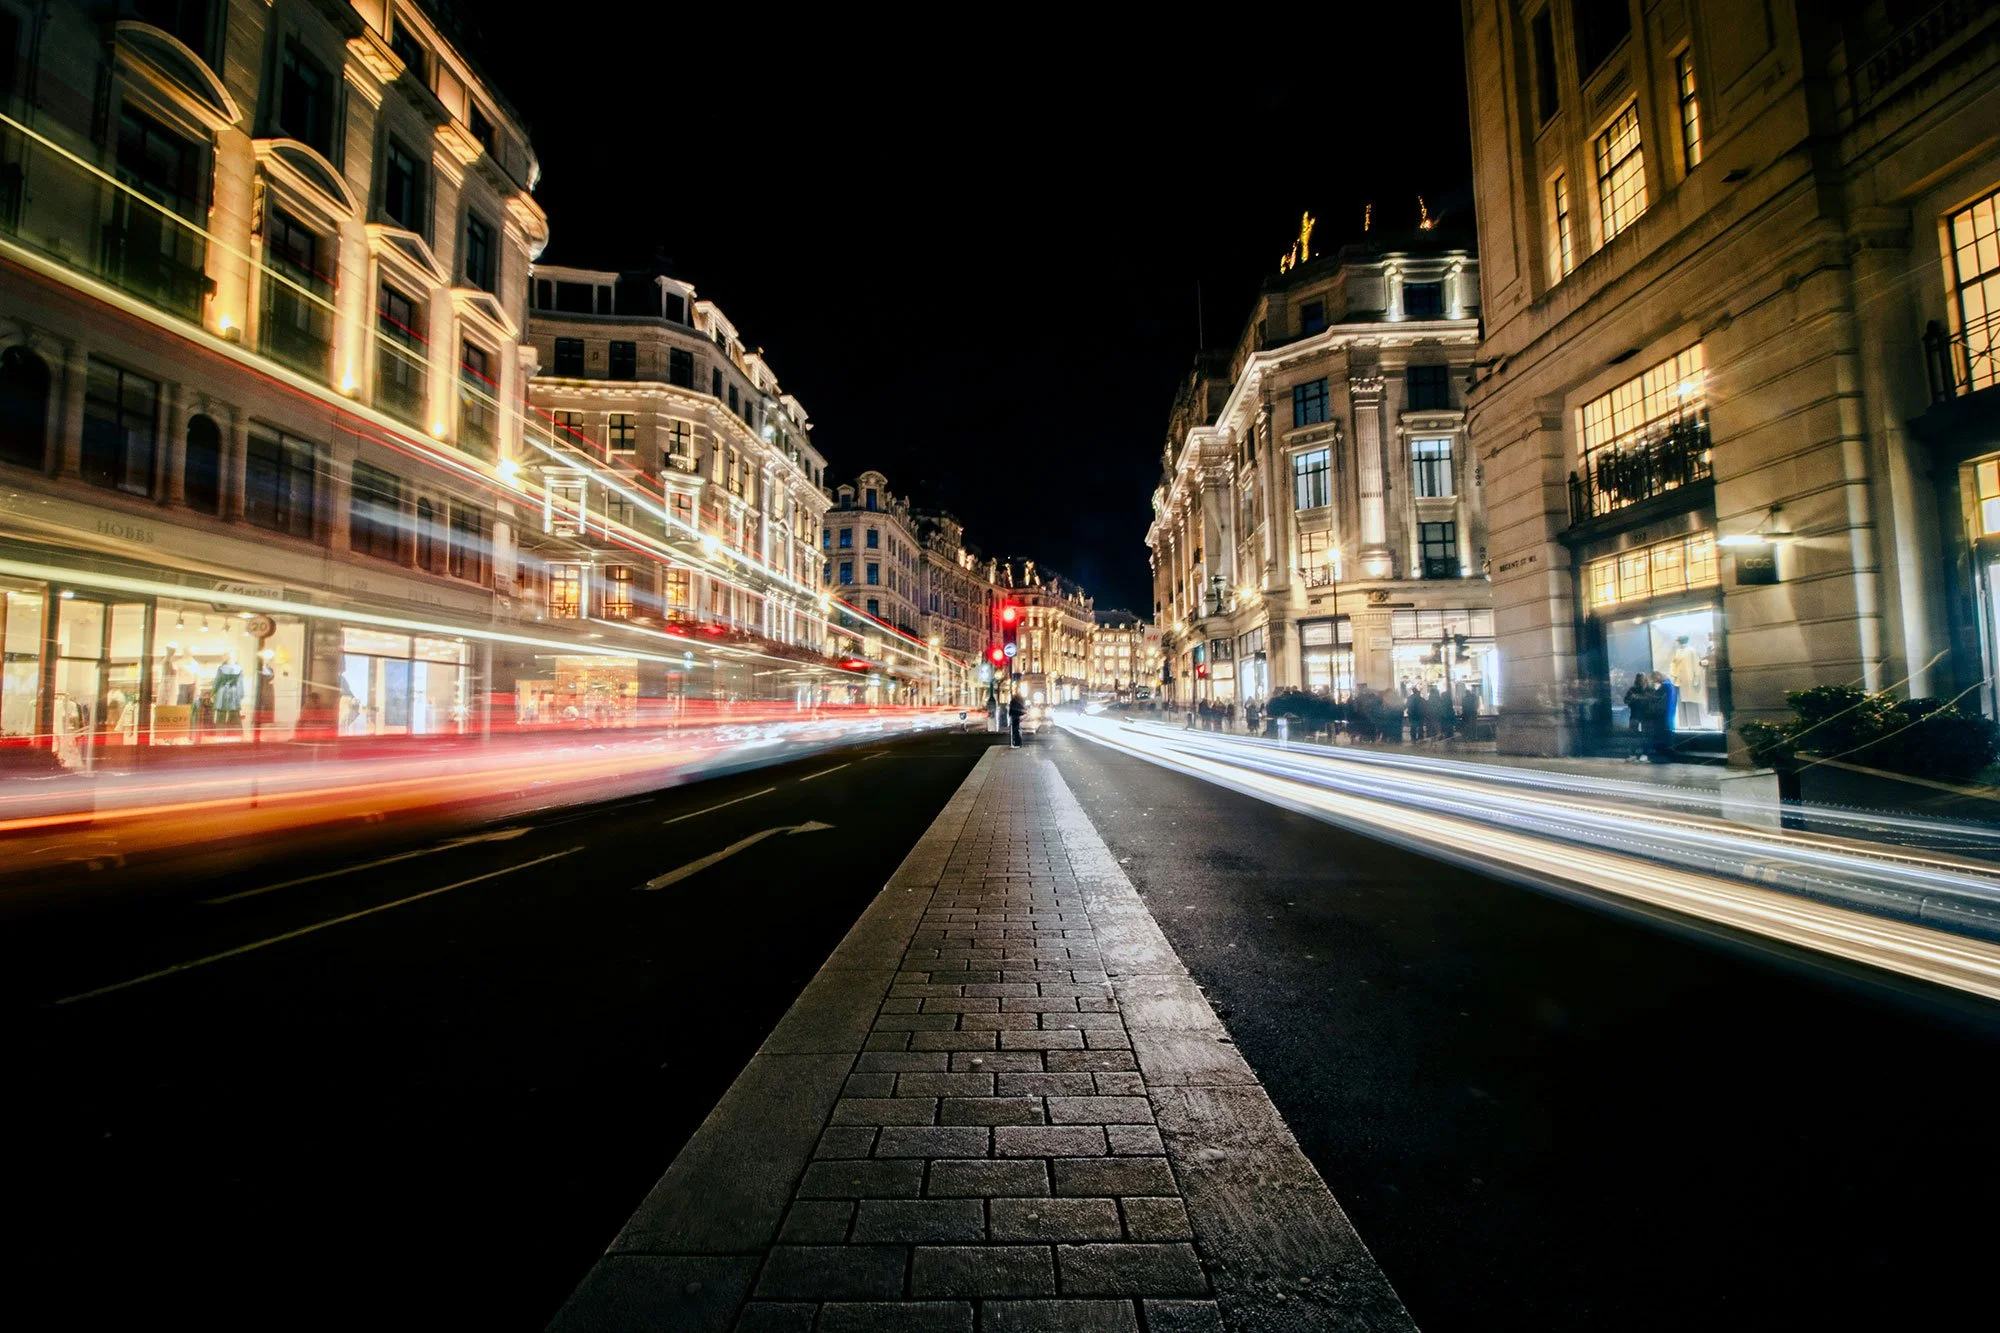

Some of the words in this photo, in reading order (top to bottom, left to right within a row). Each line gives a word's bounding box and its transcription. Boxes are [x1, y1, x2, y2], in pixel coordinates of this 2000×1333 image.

[97, 520, 154, 543] HOBBS
[1744, 558, 1772, 569] COS
[232, 587, 279, 598] Marble
[251, 621, 268, 631] 20
